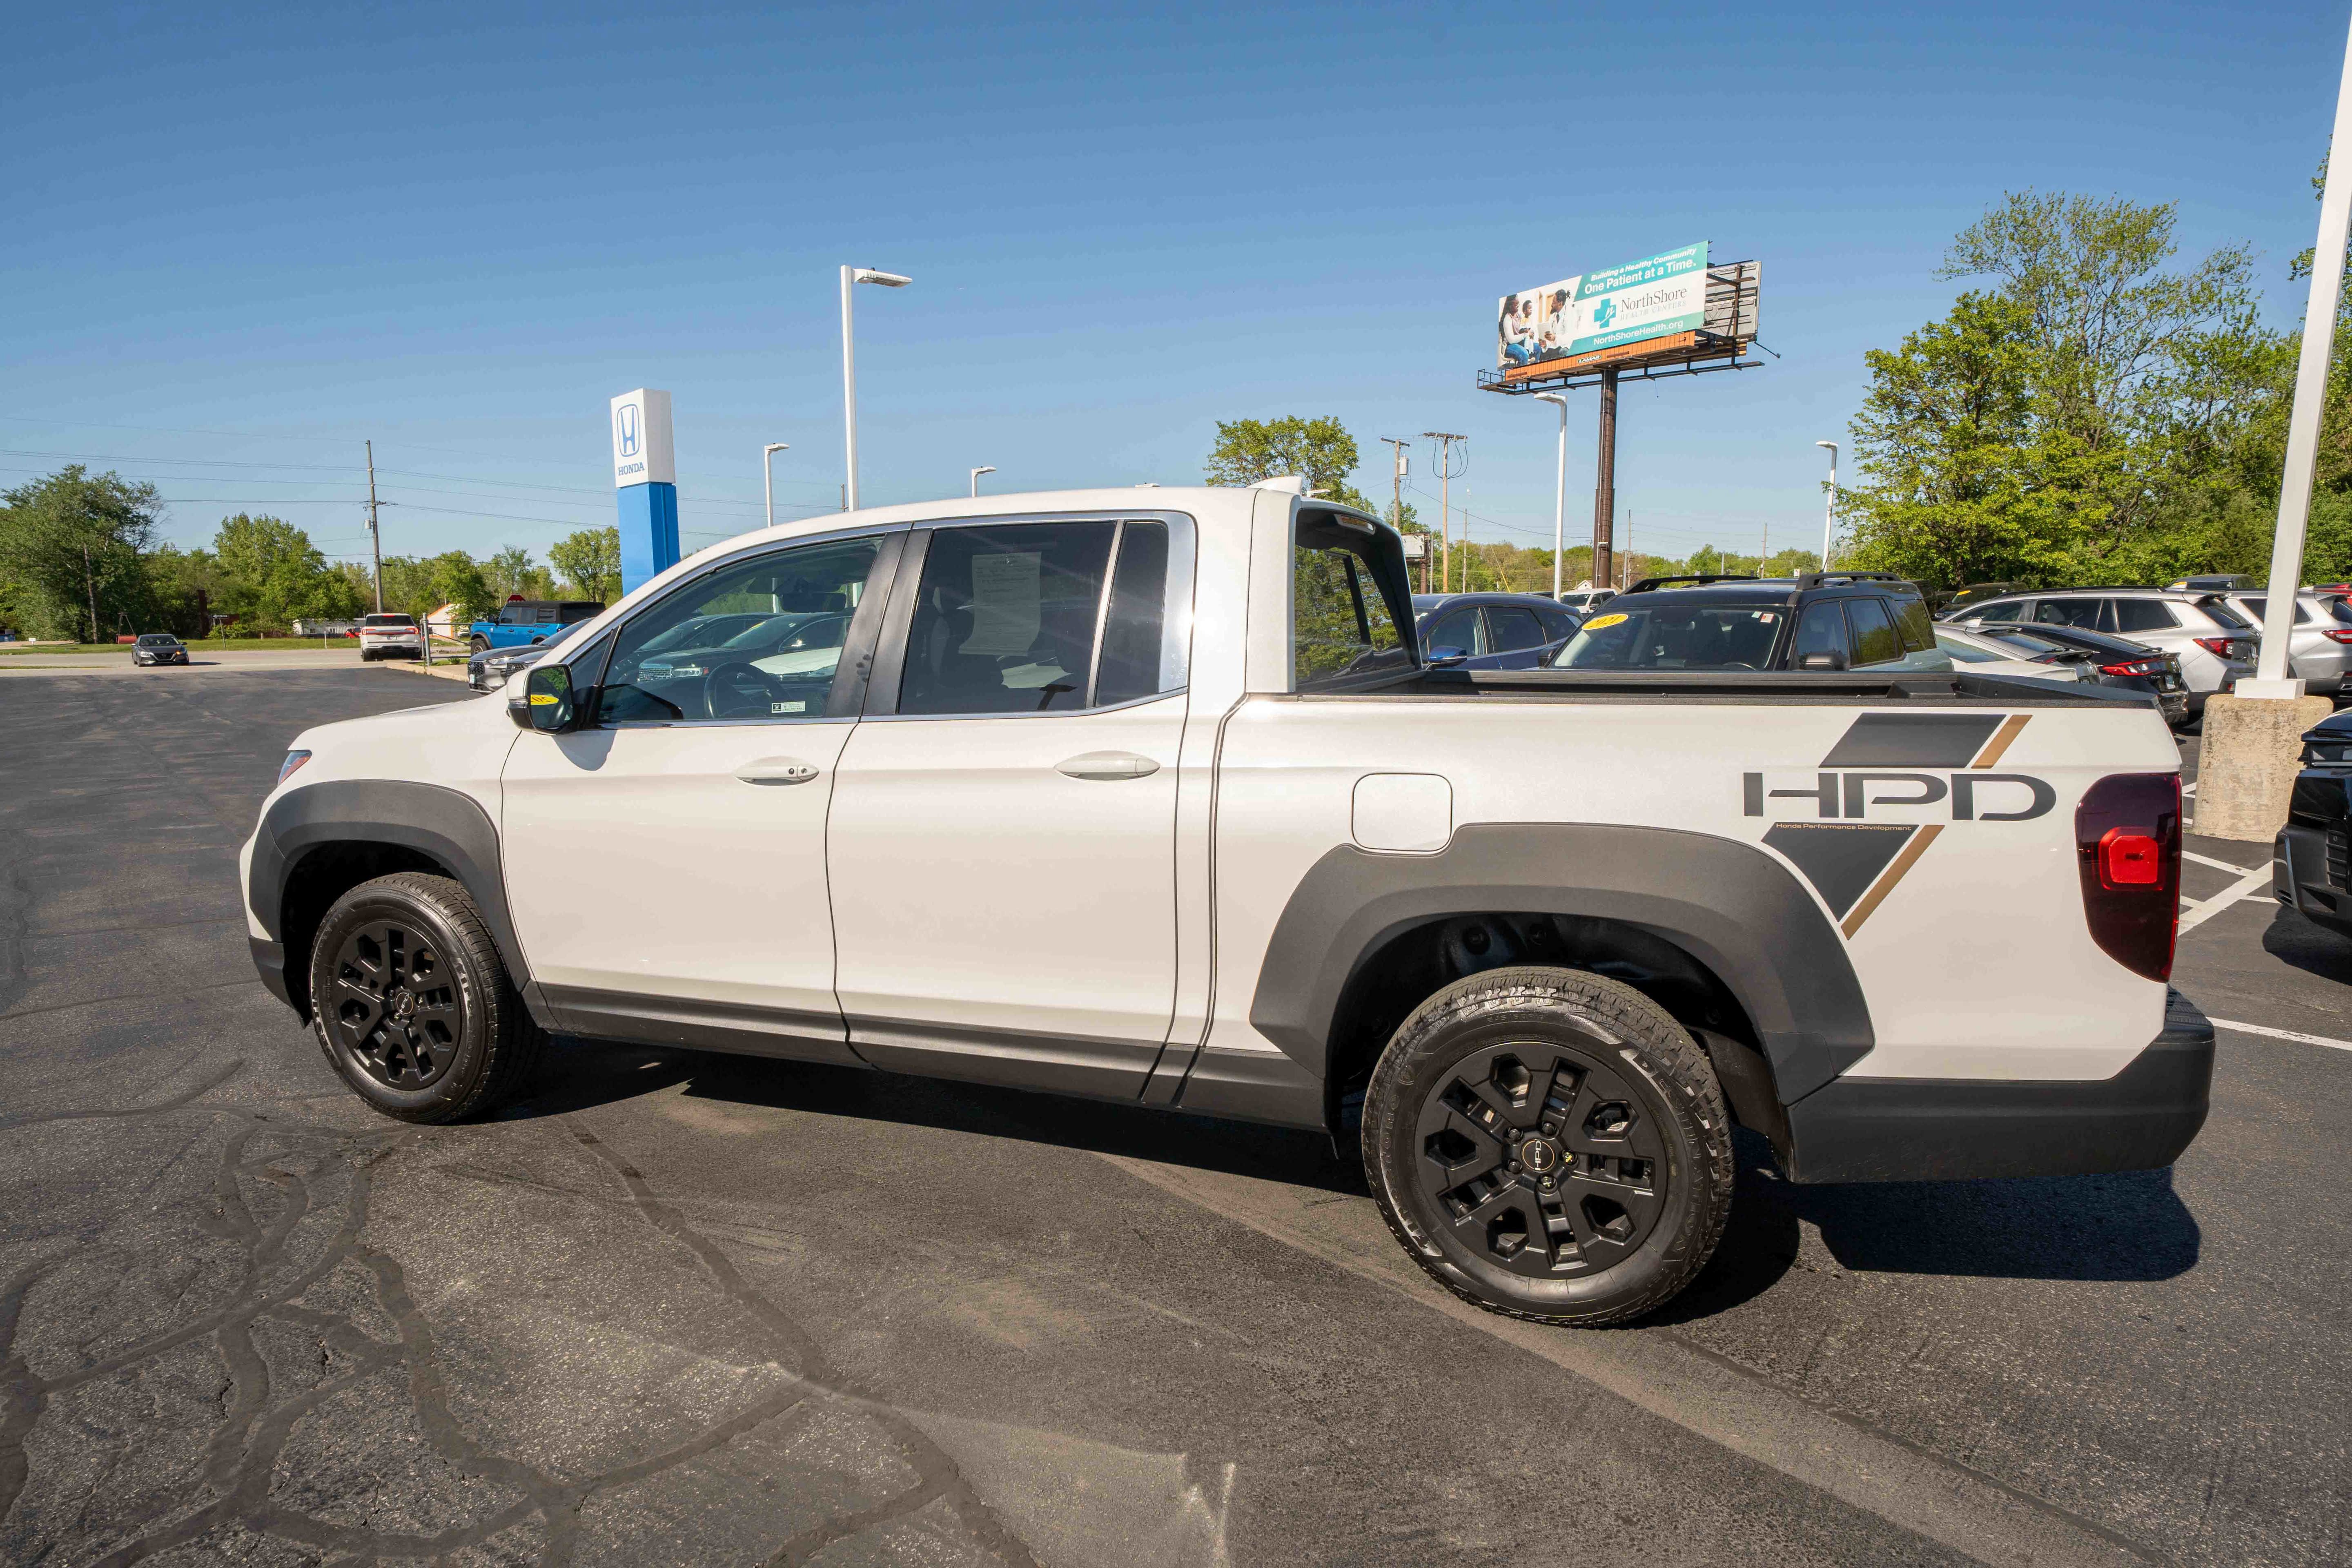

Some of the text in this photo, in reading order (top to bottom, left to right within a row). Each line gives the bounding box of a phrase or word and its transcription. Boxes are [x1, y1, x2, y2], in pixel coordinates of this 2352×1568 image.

[1584, 258, 1697, 294] One Patient at a Time.
[1591, 268, 1619, 282] Building
[1625, 259, 1653, 273] Healthy
[1653, 247, 1697, 265] Community
[1620, 301, 1686, 321] HEALTH CENTERS
[1621, 288, 1687, 312] NorthShore
[1593, 320, 1684, 345] NorthShoreHealth.org
[1579, 355, 1600, 363] LAMAR
[618, 462, 645, 476] HONDA
[1743, 772, 2057, 821] HPD
[400, 994, 409, 1013] HPD
